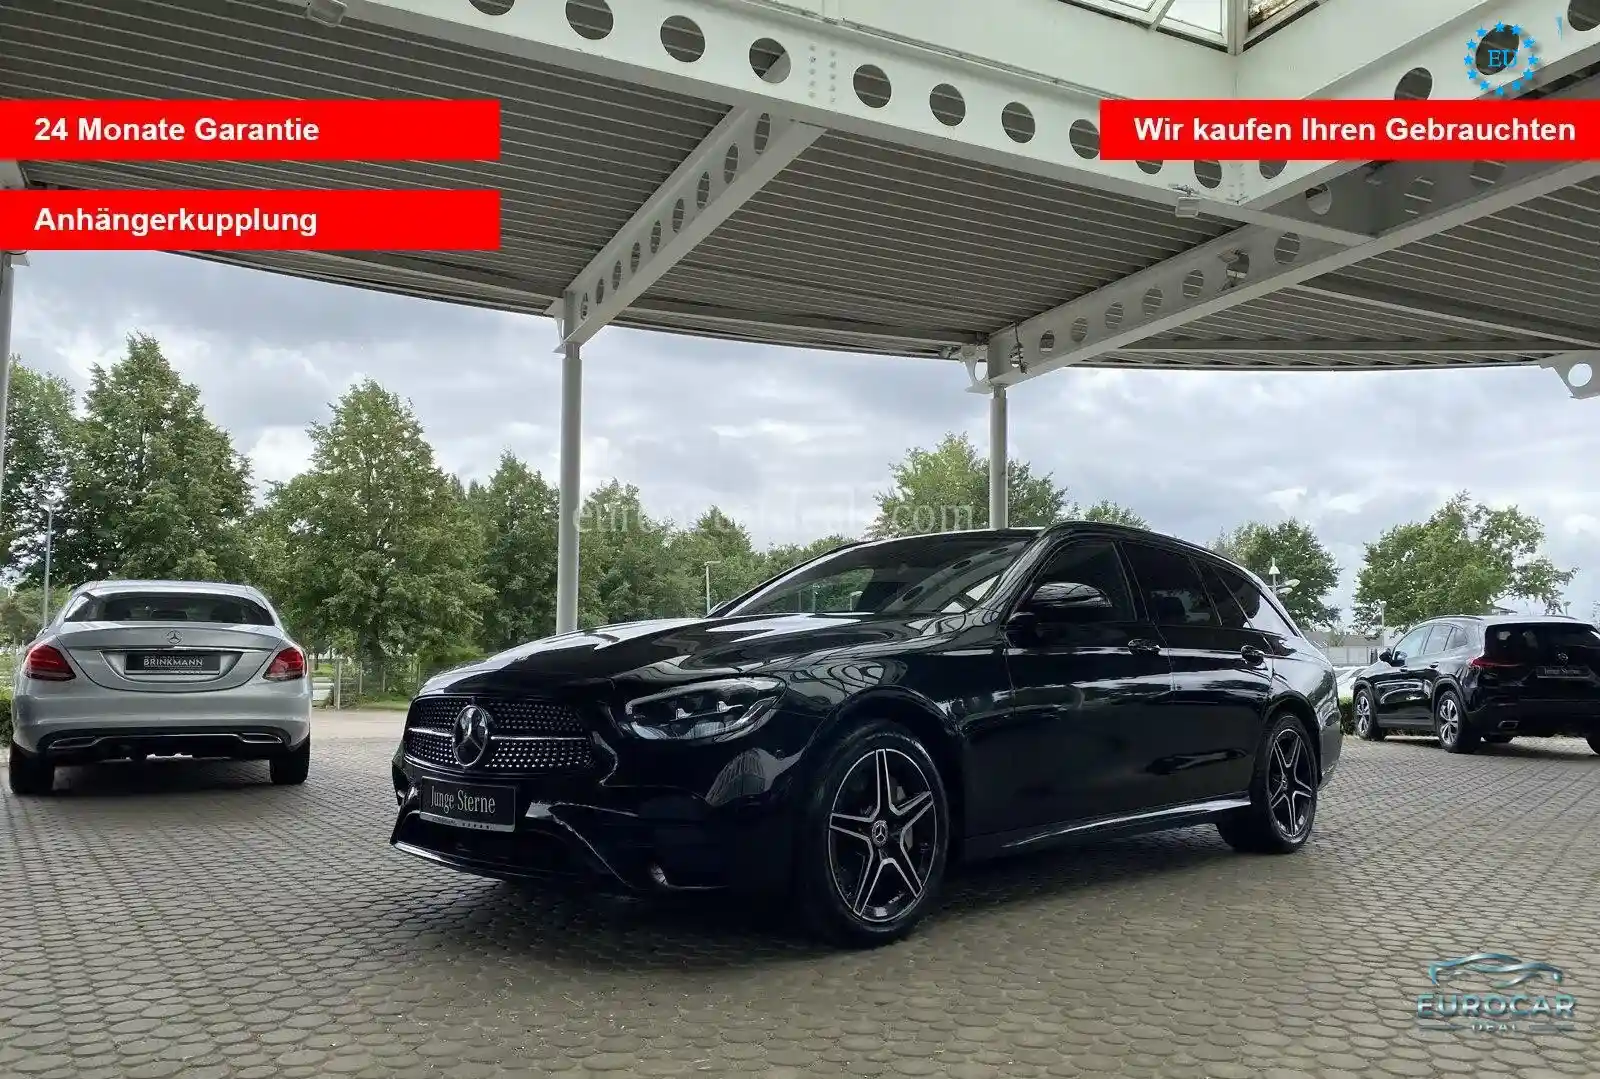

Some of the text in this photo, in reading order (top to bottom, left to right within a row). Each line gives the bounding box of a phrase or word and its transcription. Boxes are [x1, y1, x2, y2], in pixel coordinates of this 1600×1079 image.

[143, 658, 203, 667] BRINKMANN
[430, 785, 496, 814] Junge Sterne
